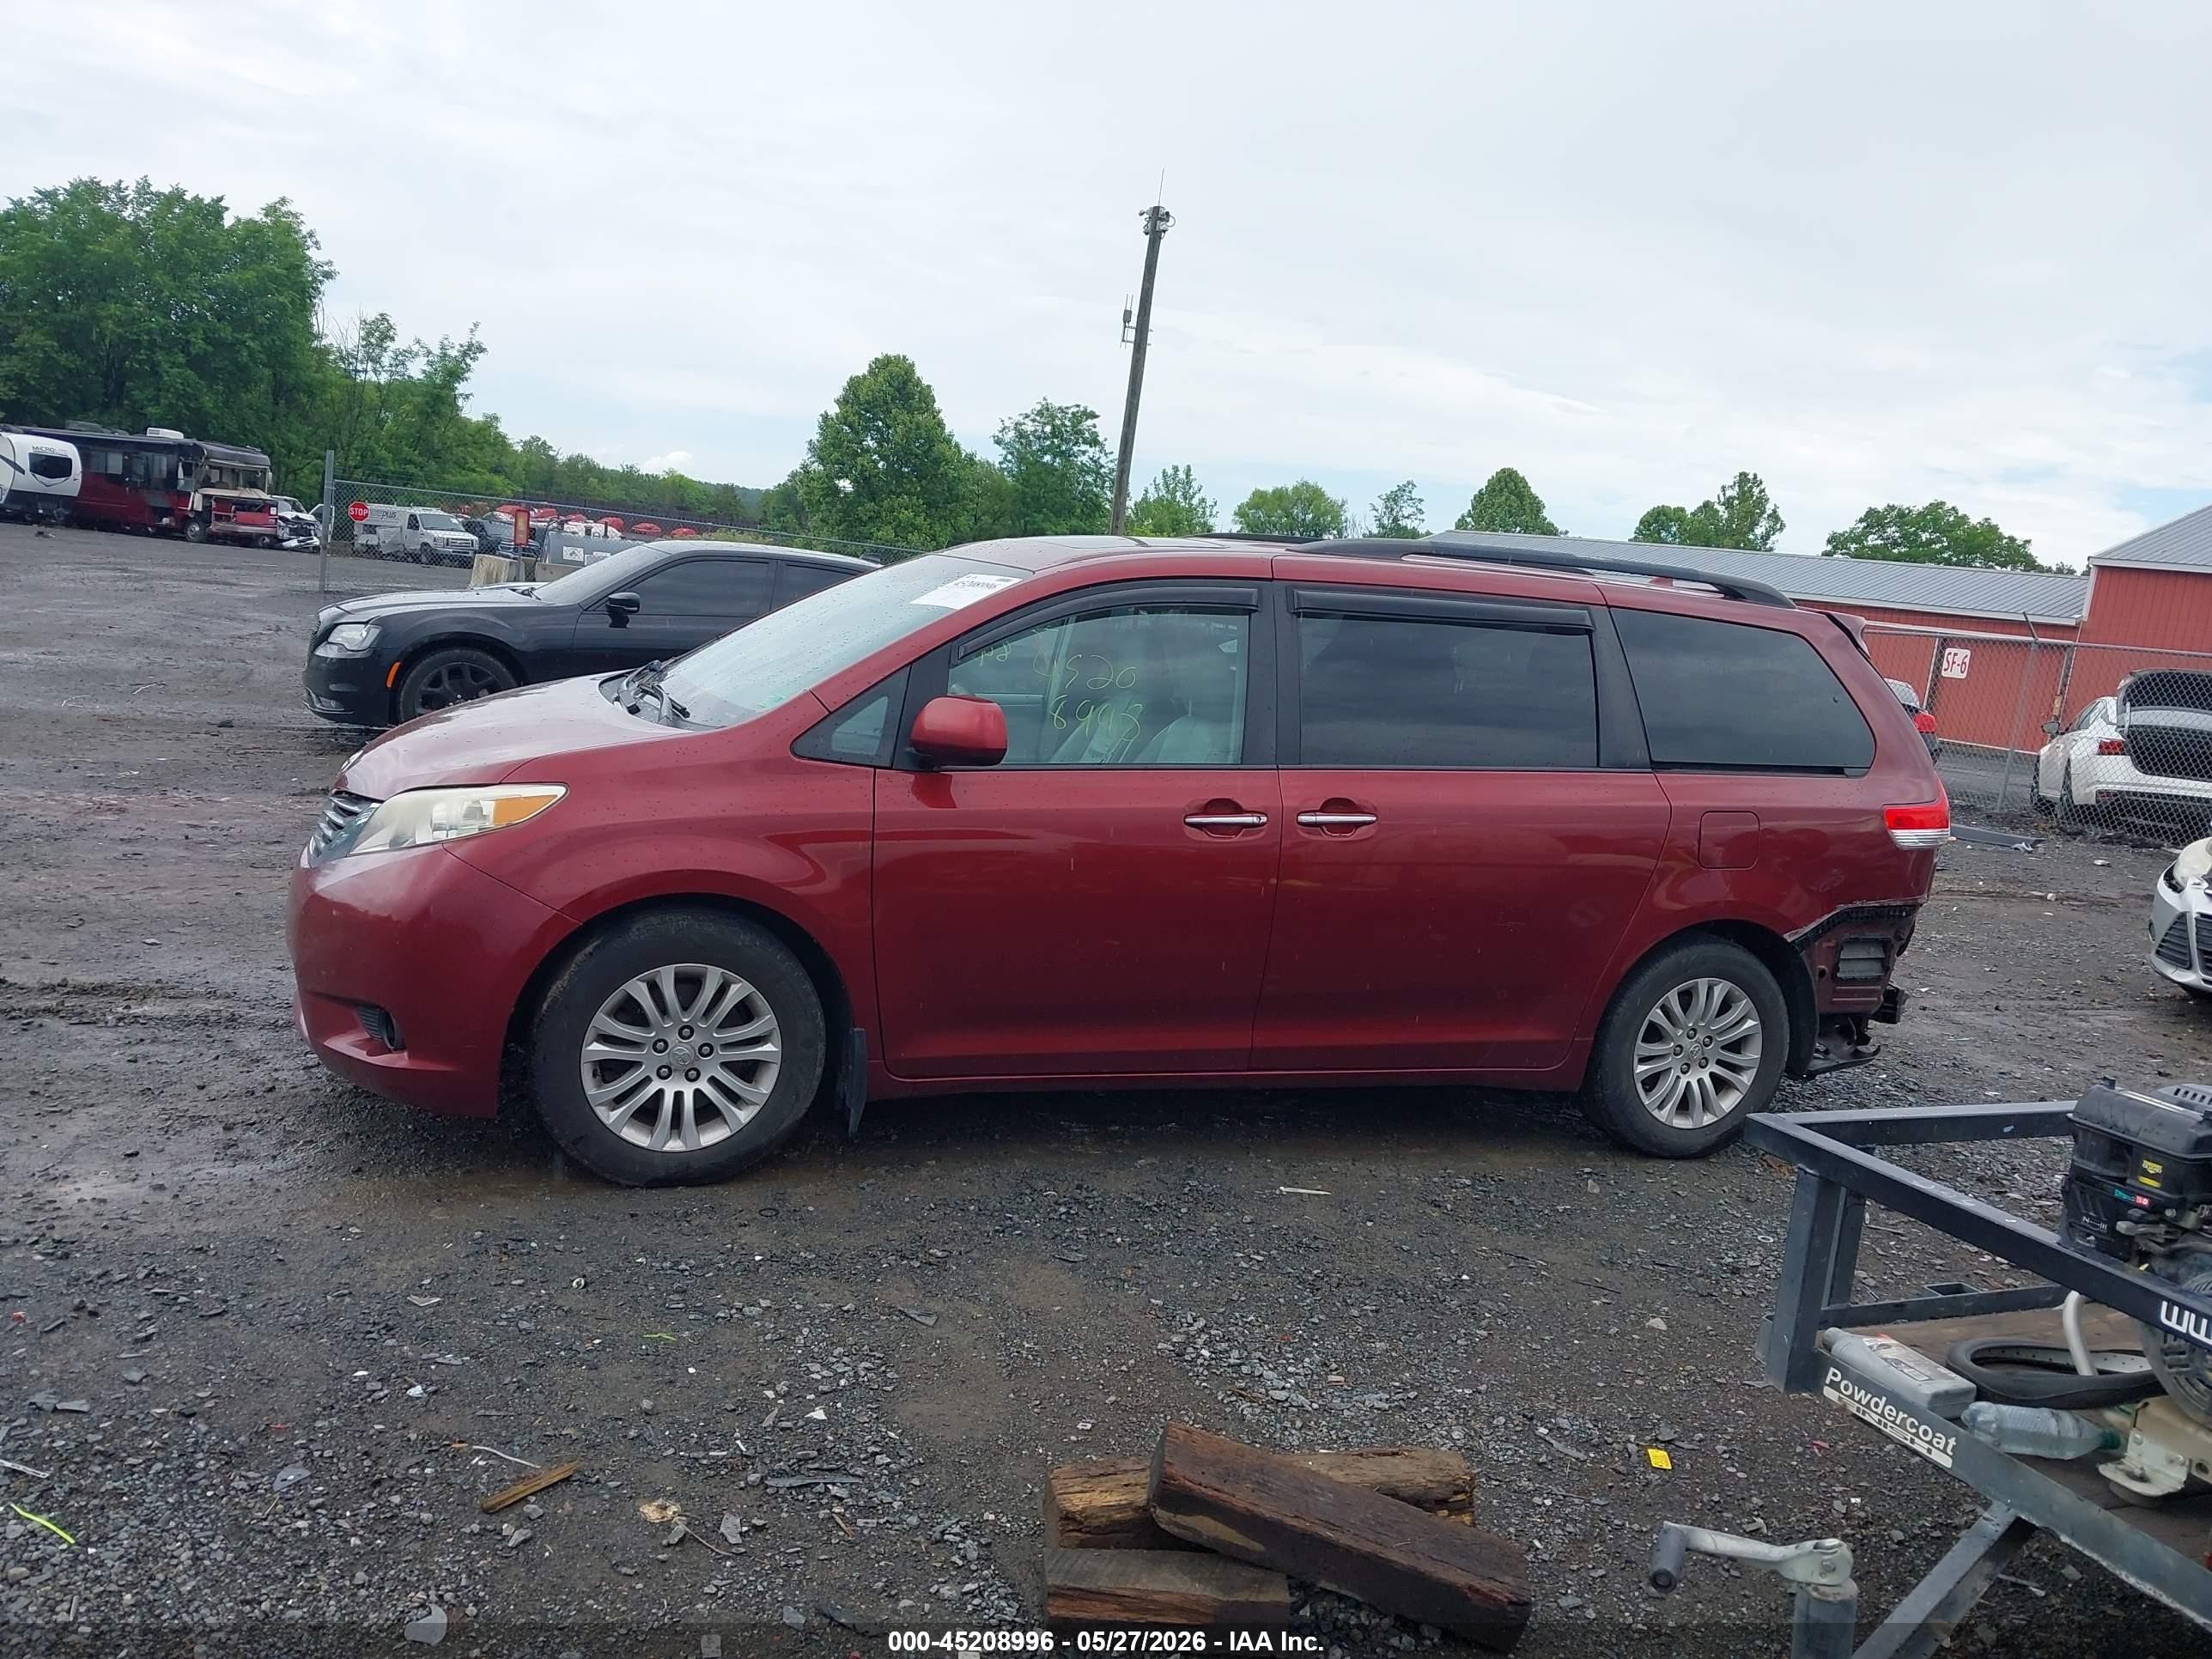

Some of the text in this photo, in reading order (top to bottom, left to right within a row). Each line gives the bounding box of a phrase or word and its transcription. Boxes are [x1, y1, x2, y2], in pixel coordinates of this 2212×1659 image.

[349, 507, 368, 516] STOP
[1943, 651, 1968, 674] SF-6
[1825, 1366, 1957, 1456] Powdercoat
